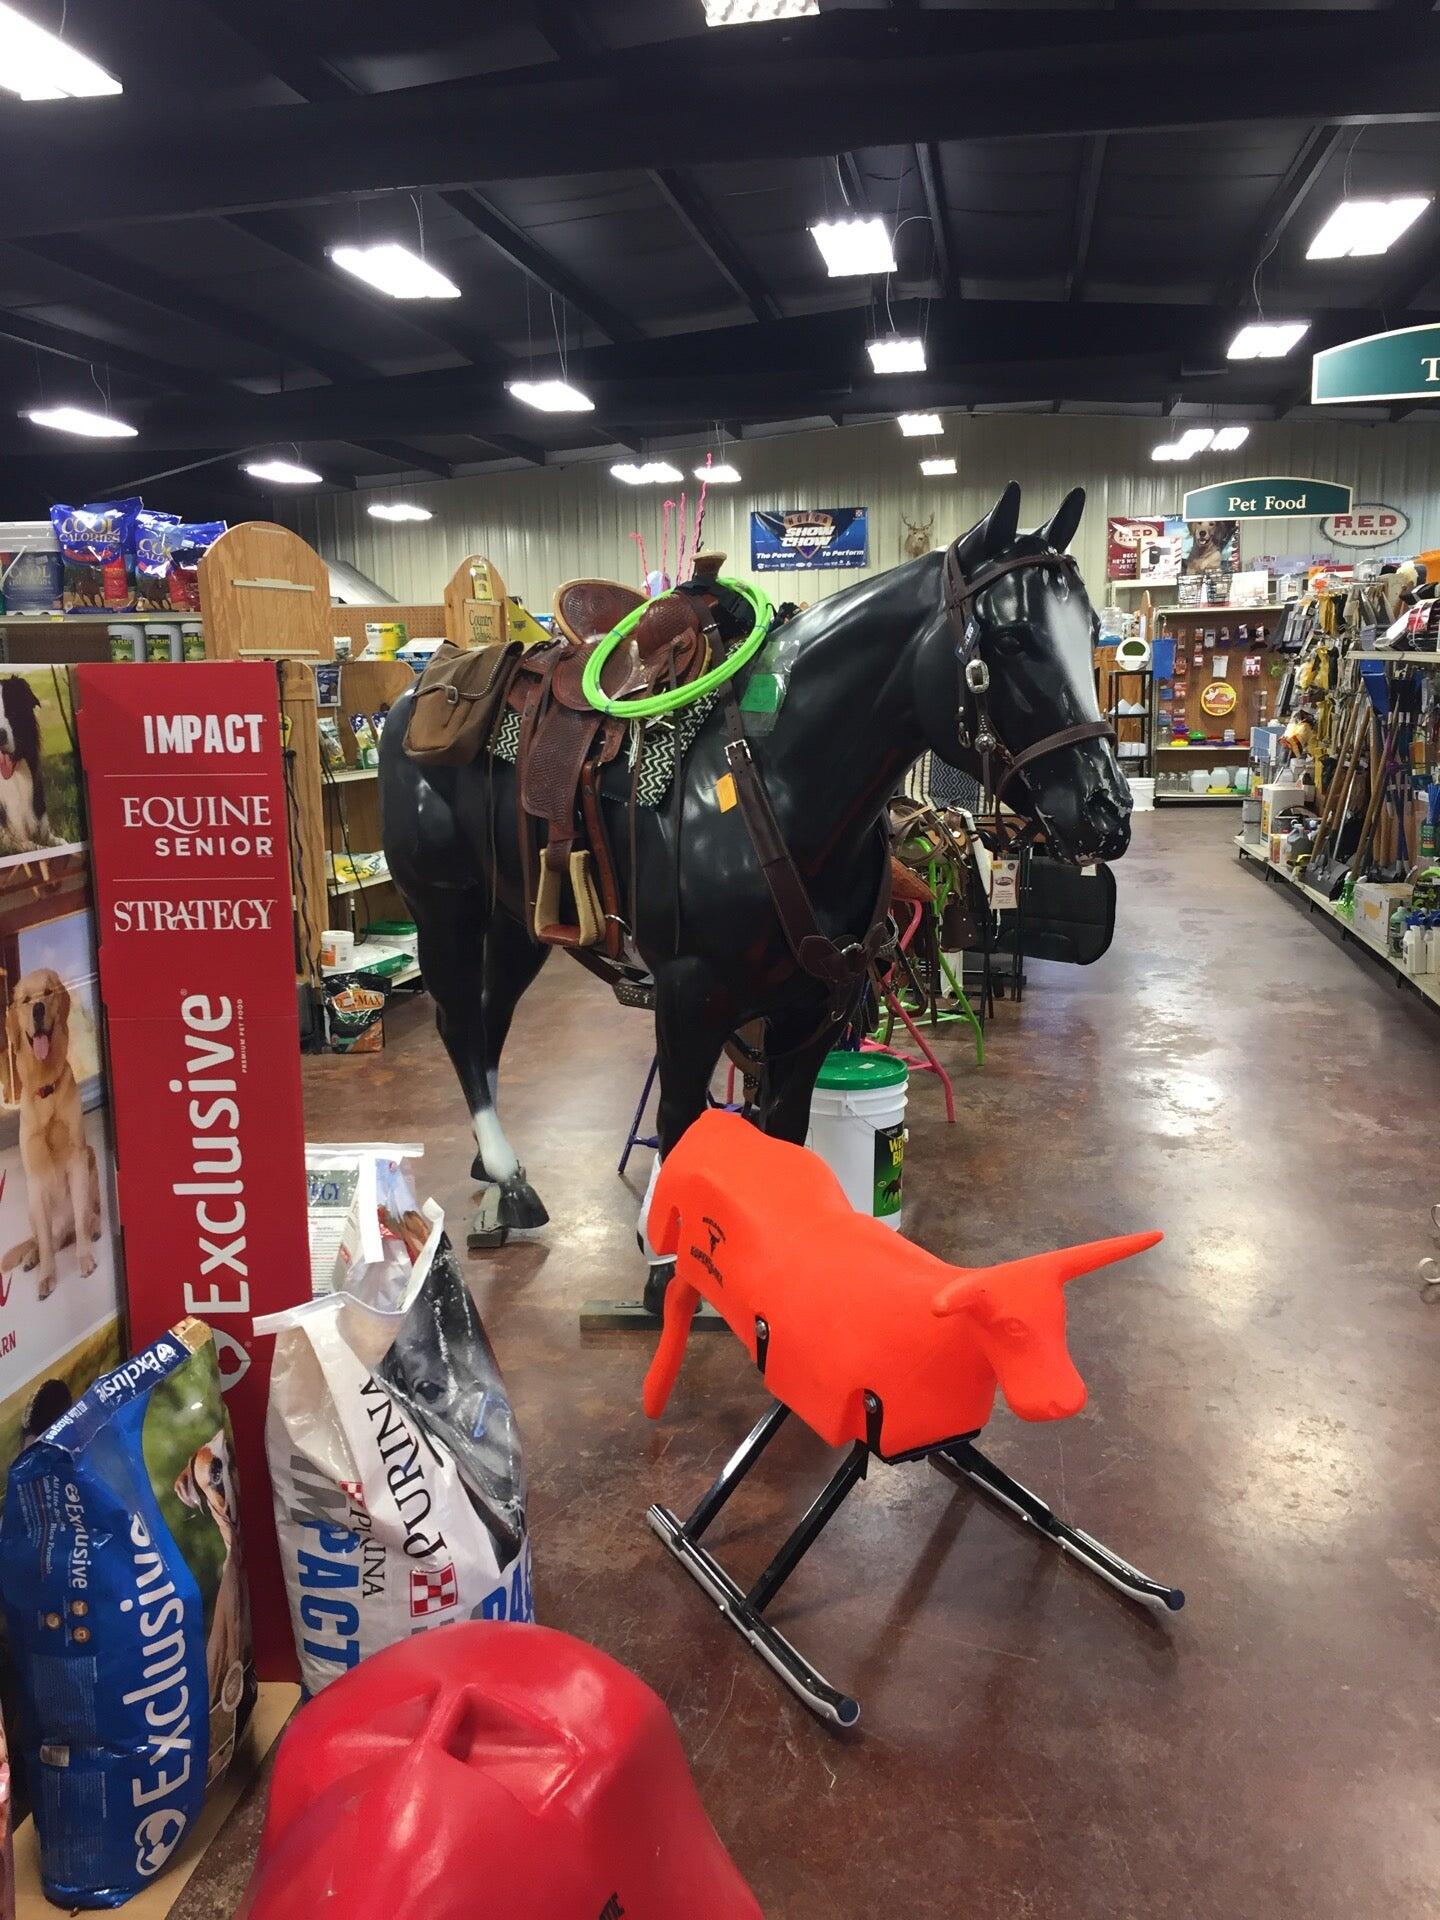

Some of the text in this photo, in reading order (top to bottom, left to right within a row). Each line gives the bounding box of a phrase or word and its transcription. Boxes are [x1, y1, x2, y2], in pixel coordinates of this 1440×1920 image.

[1227, 494, 1306, 512] Pet Food
[784, 525, 836, 537] SHOW
[1333, 514, 1398, 529] RED
[58, 532, 121, 543] CALORIES
[780, 536, 832, 547] CHOW
[1333, 529, 1396, 537] FLANNEL
[832, 549, 864, 557] Perform
[143, 713, 264, 754] IMPACT
[121, 795, 272, 834] EQUINE
[155, 837, 273, 857] SENIOR
[113, 899, 275, 932] STRATEGY
[236, 998, 248, 1074] PREMIUM PET FOOD
[168, 994, 251, 1314] Exclusive
[359, 1376, 448, 1559] PURINA
